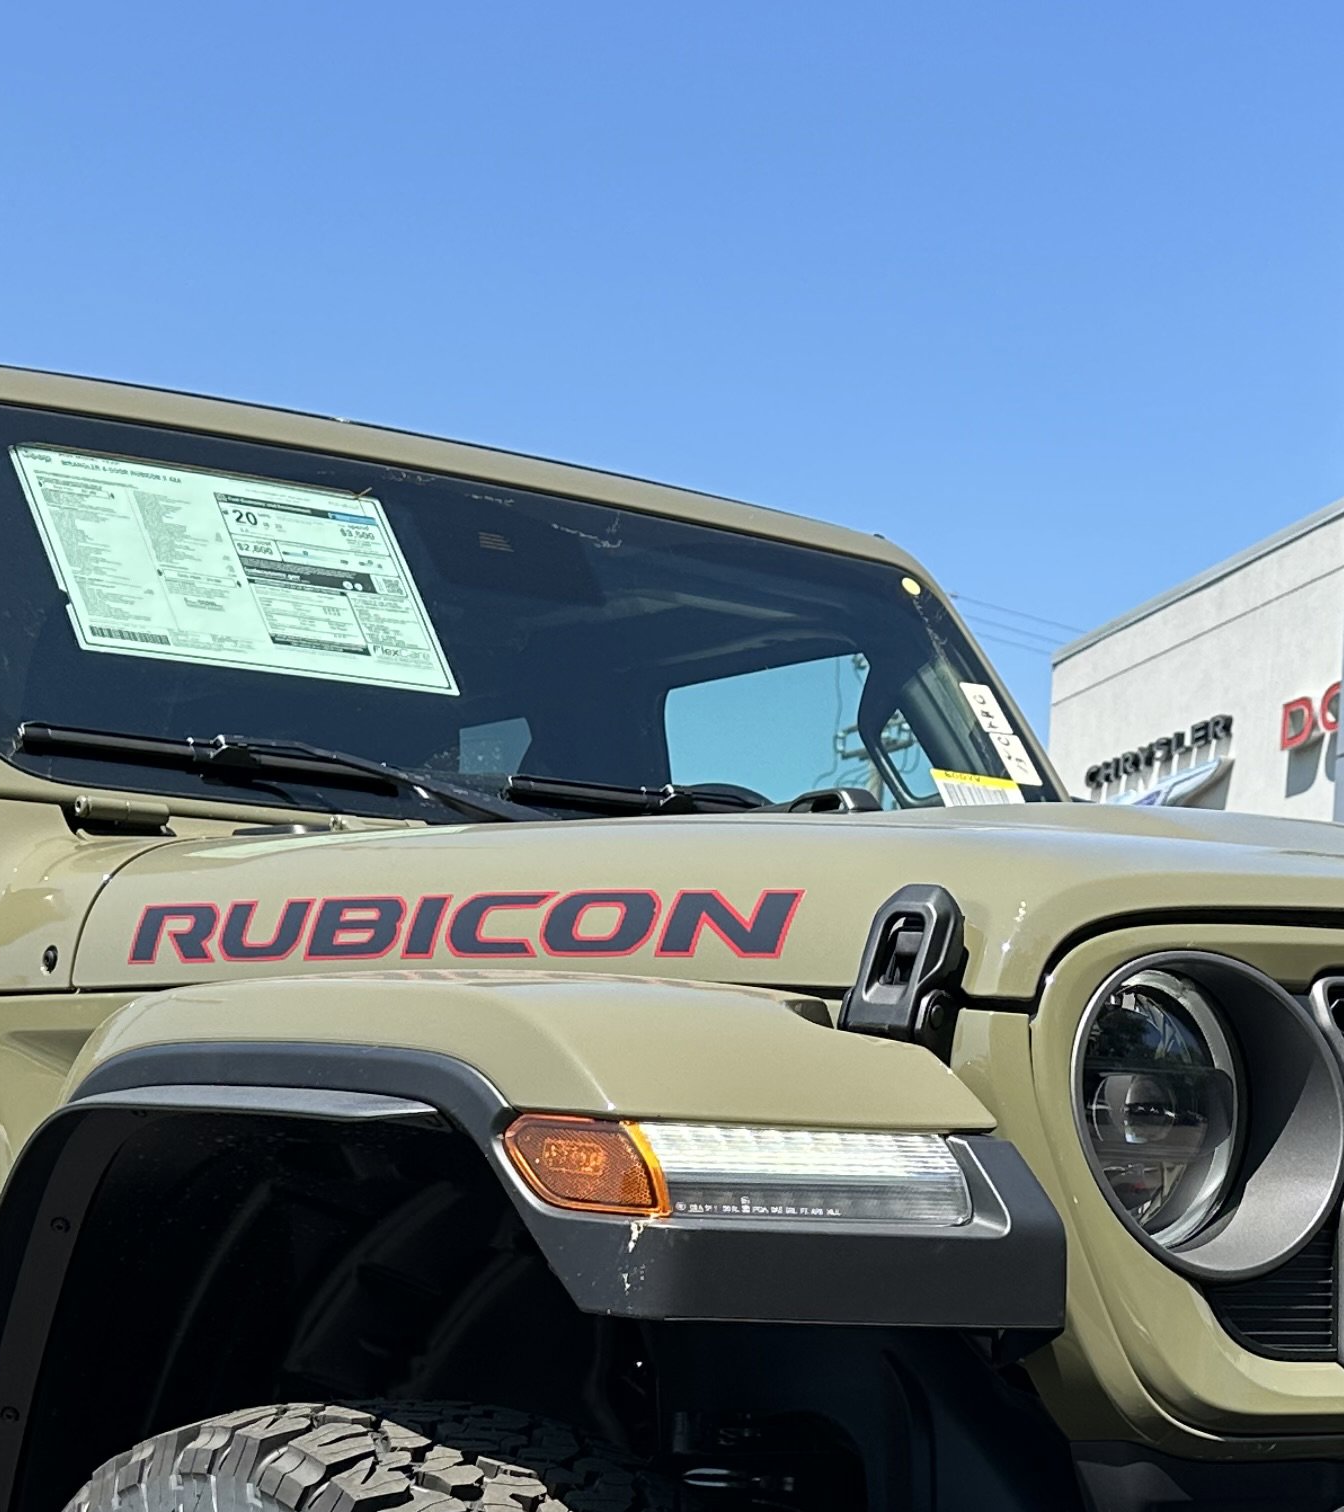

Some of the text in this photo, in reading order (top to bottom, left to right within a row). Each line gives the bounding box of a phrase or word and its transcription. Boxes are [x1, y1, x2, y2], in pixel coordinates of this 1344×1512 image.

[232, 508, 258, 527] 20
[1085, 714, 1234, 789] CHRYSLER
[128, 888, 806, 964] RUBICON
